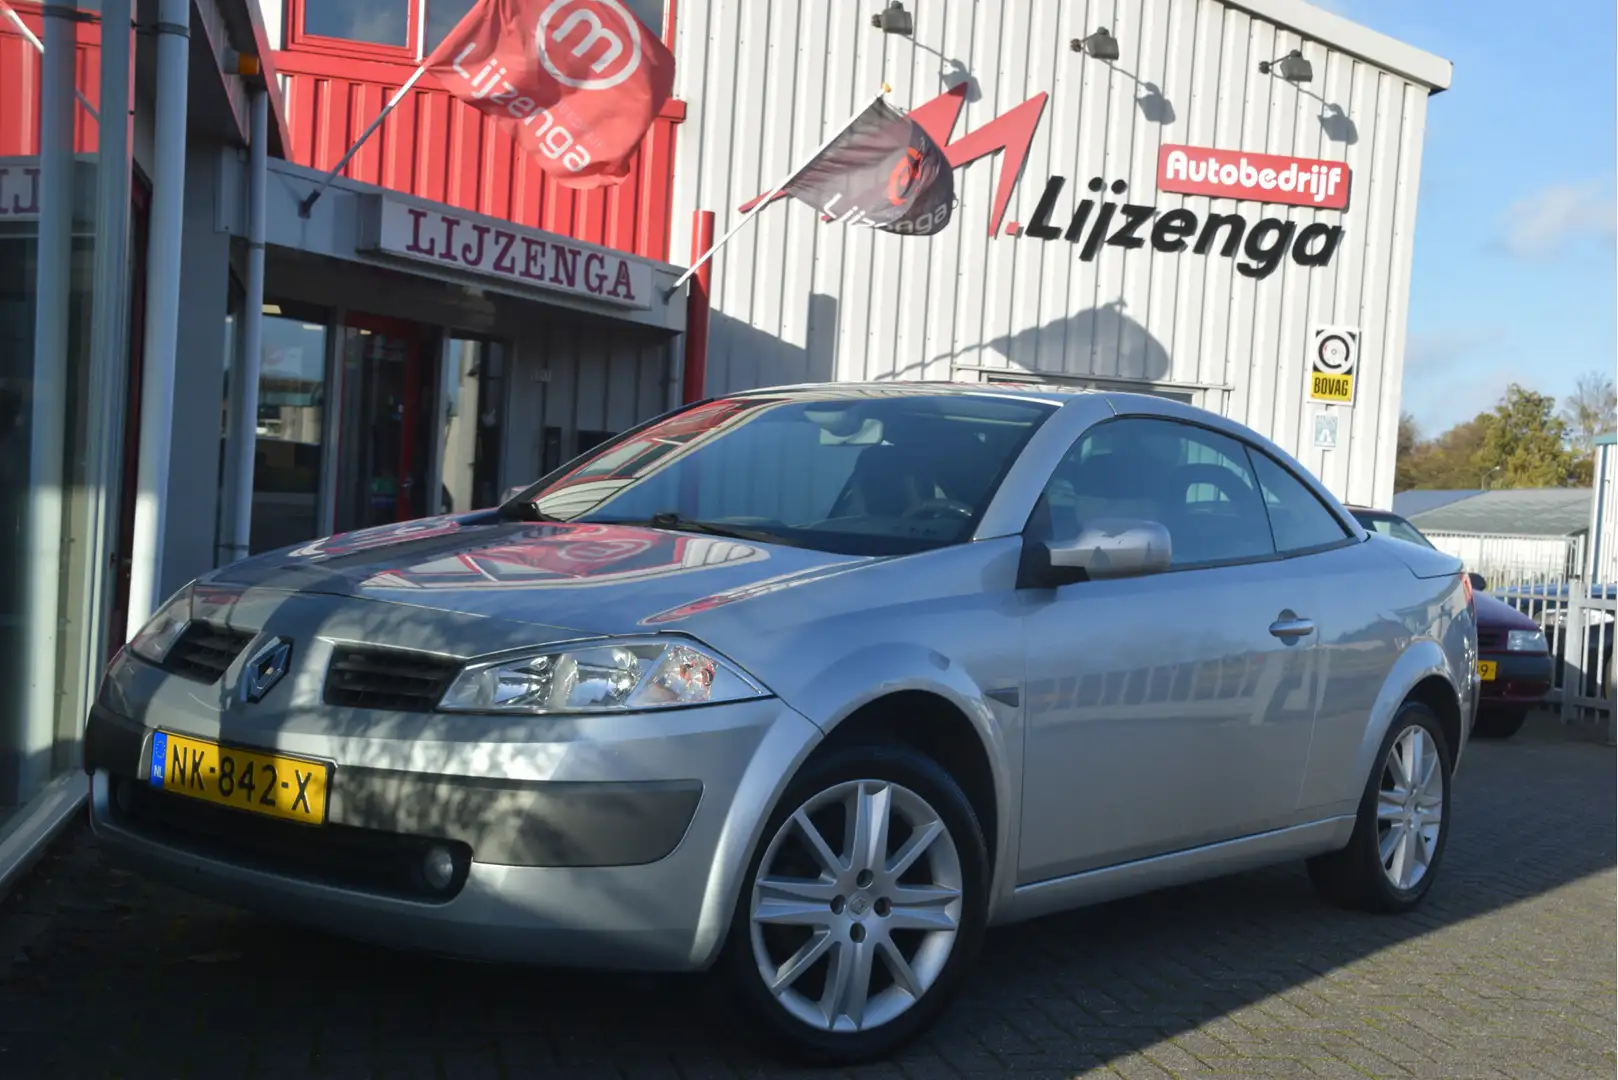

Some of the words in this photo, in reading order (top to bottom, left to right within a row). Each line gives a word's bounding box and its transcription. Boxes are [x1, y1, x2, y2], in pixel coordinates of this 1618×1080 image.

[453, 42, 592, 173] Lijzenga
[1166, 150, 1341, 202] Autobedrijf
[405, 208, 636, 301] LIJZENGA
[1025, 175, 1343, 280] Lijzenga
[1313, 376, 1349, 397] BOVAG
[153, 764, 164, 779] NL
[171, 744, 313, 814] NK-842-X
